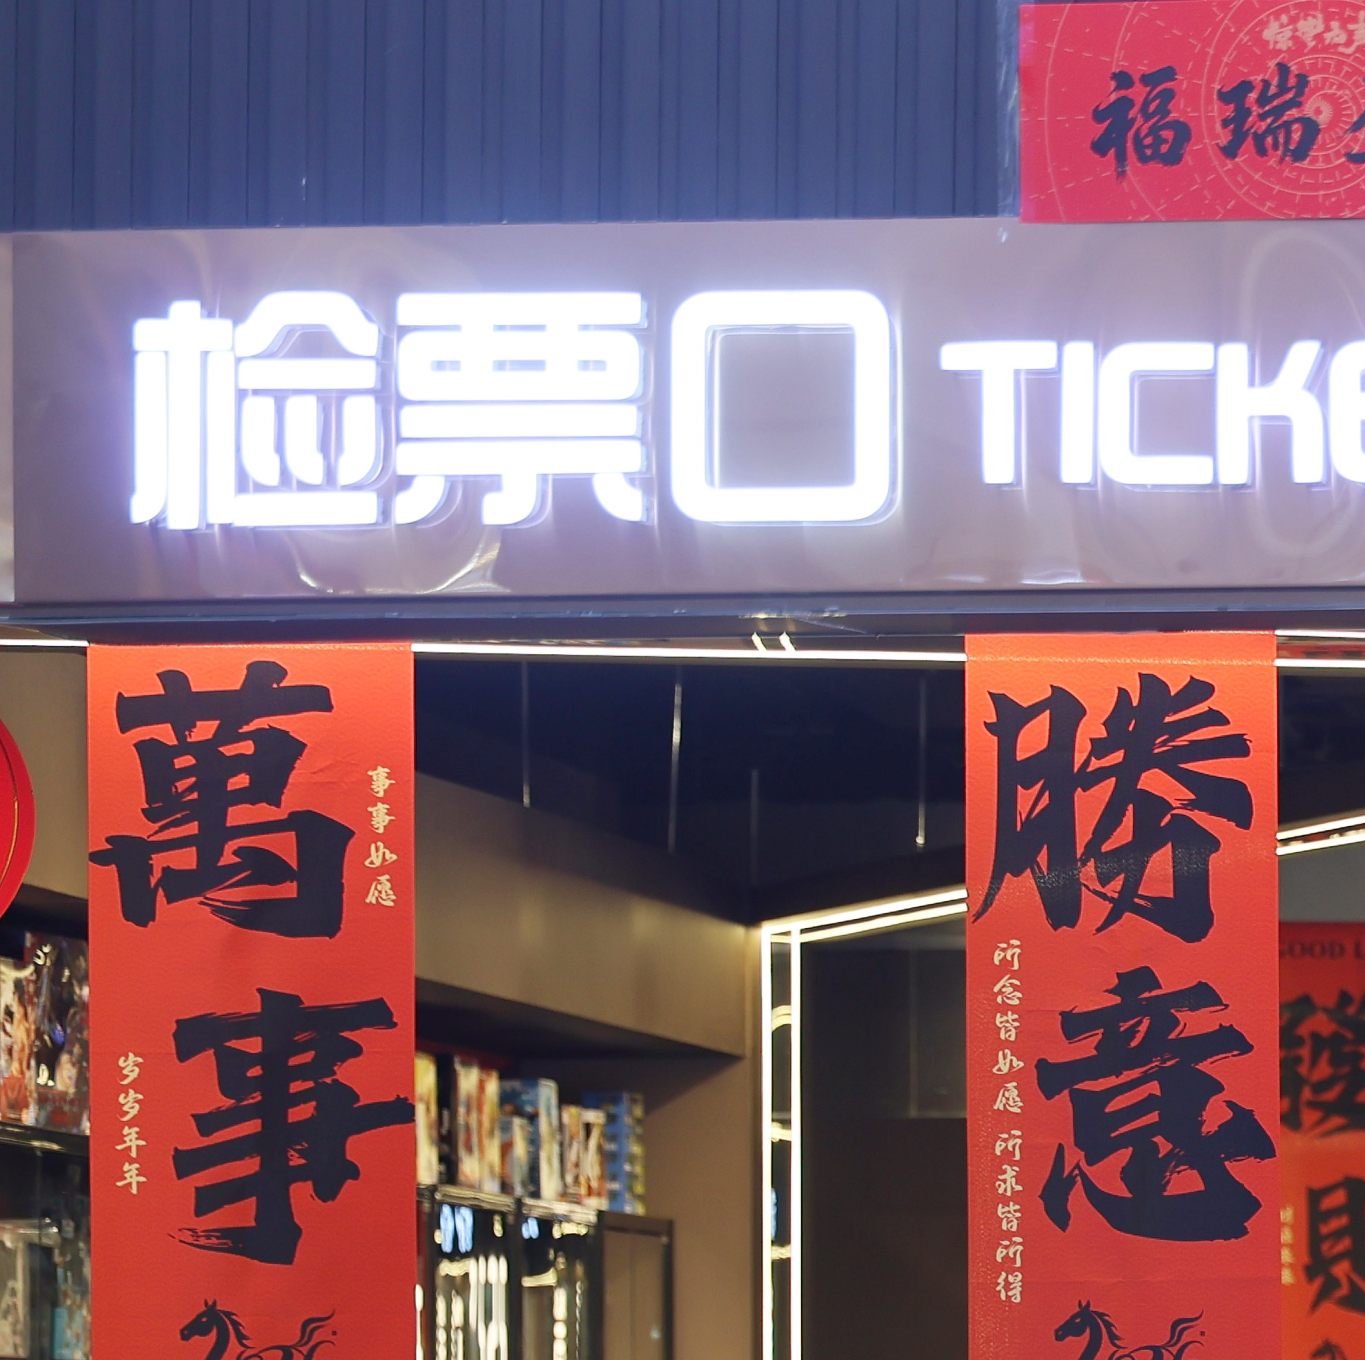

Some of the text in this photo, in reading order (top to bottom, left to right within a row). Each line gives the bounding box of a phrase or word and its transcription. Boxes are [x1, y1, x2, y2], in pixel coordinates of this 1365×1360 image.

[129, 289, 897, 531] 检票口
[364, 765, 397, 906] 事事如愿
[972, 672, 1276, 1241] 勝意
[89, 661, 415, 1264] 萬事
[115, 1052, 147, 1195] 岁岁年年
